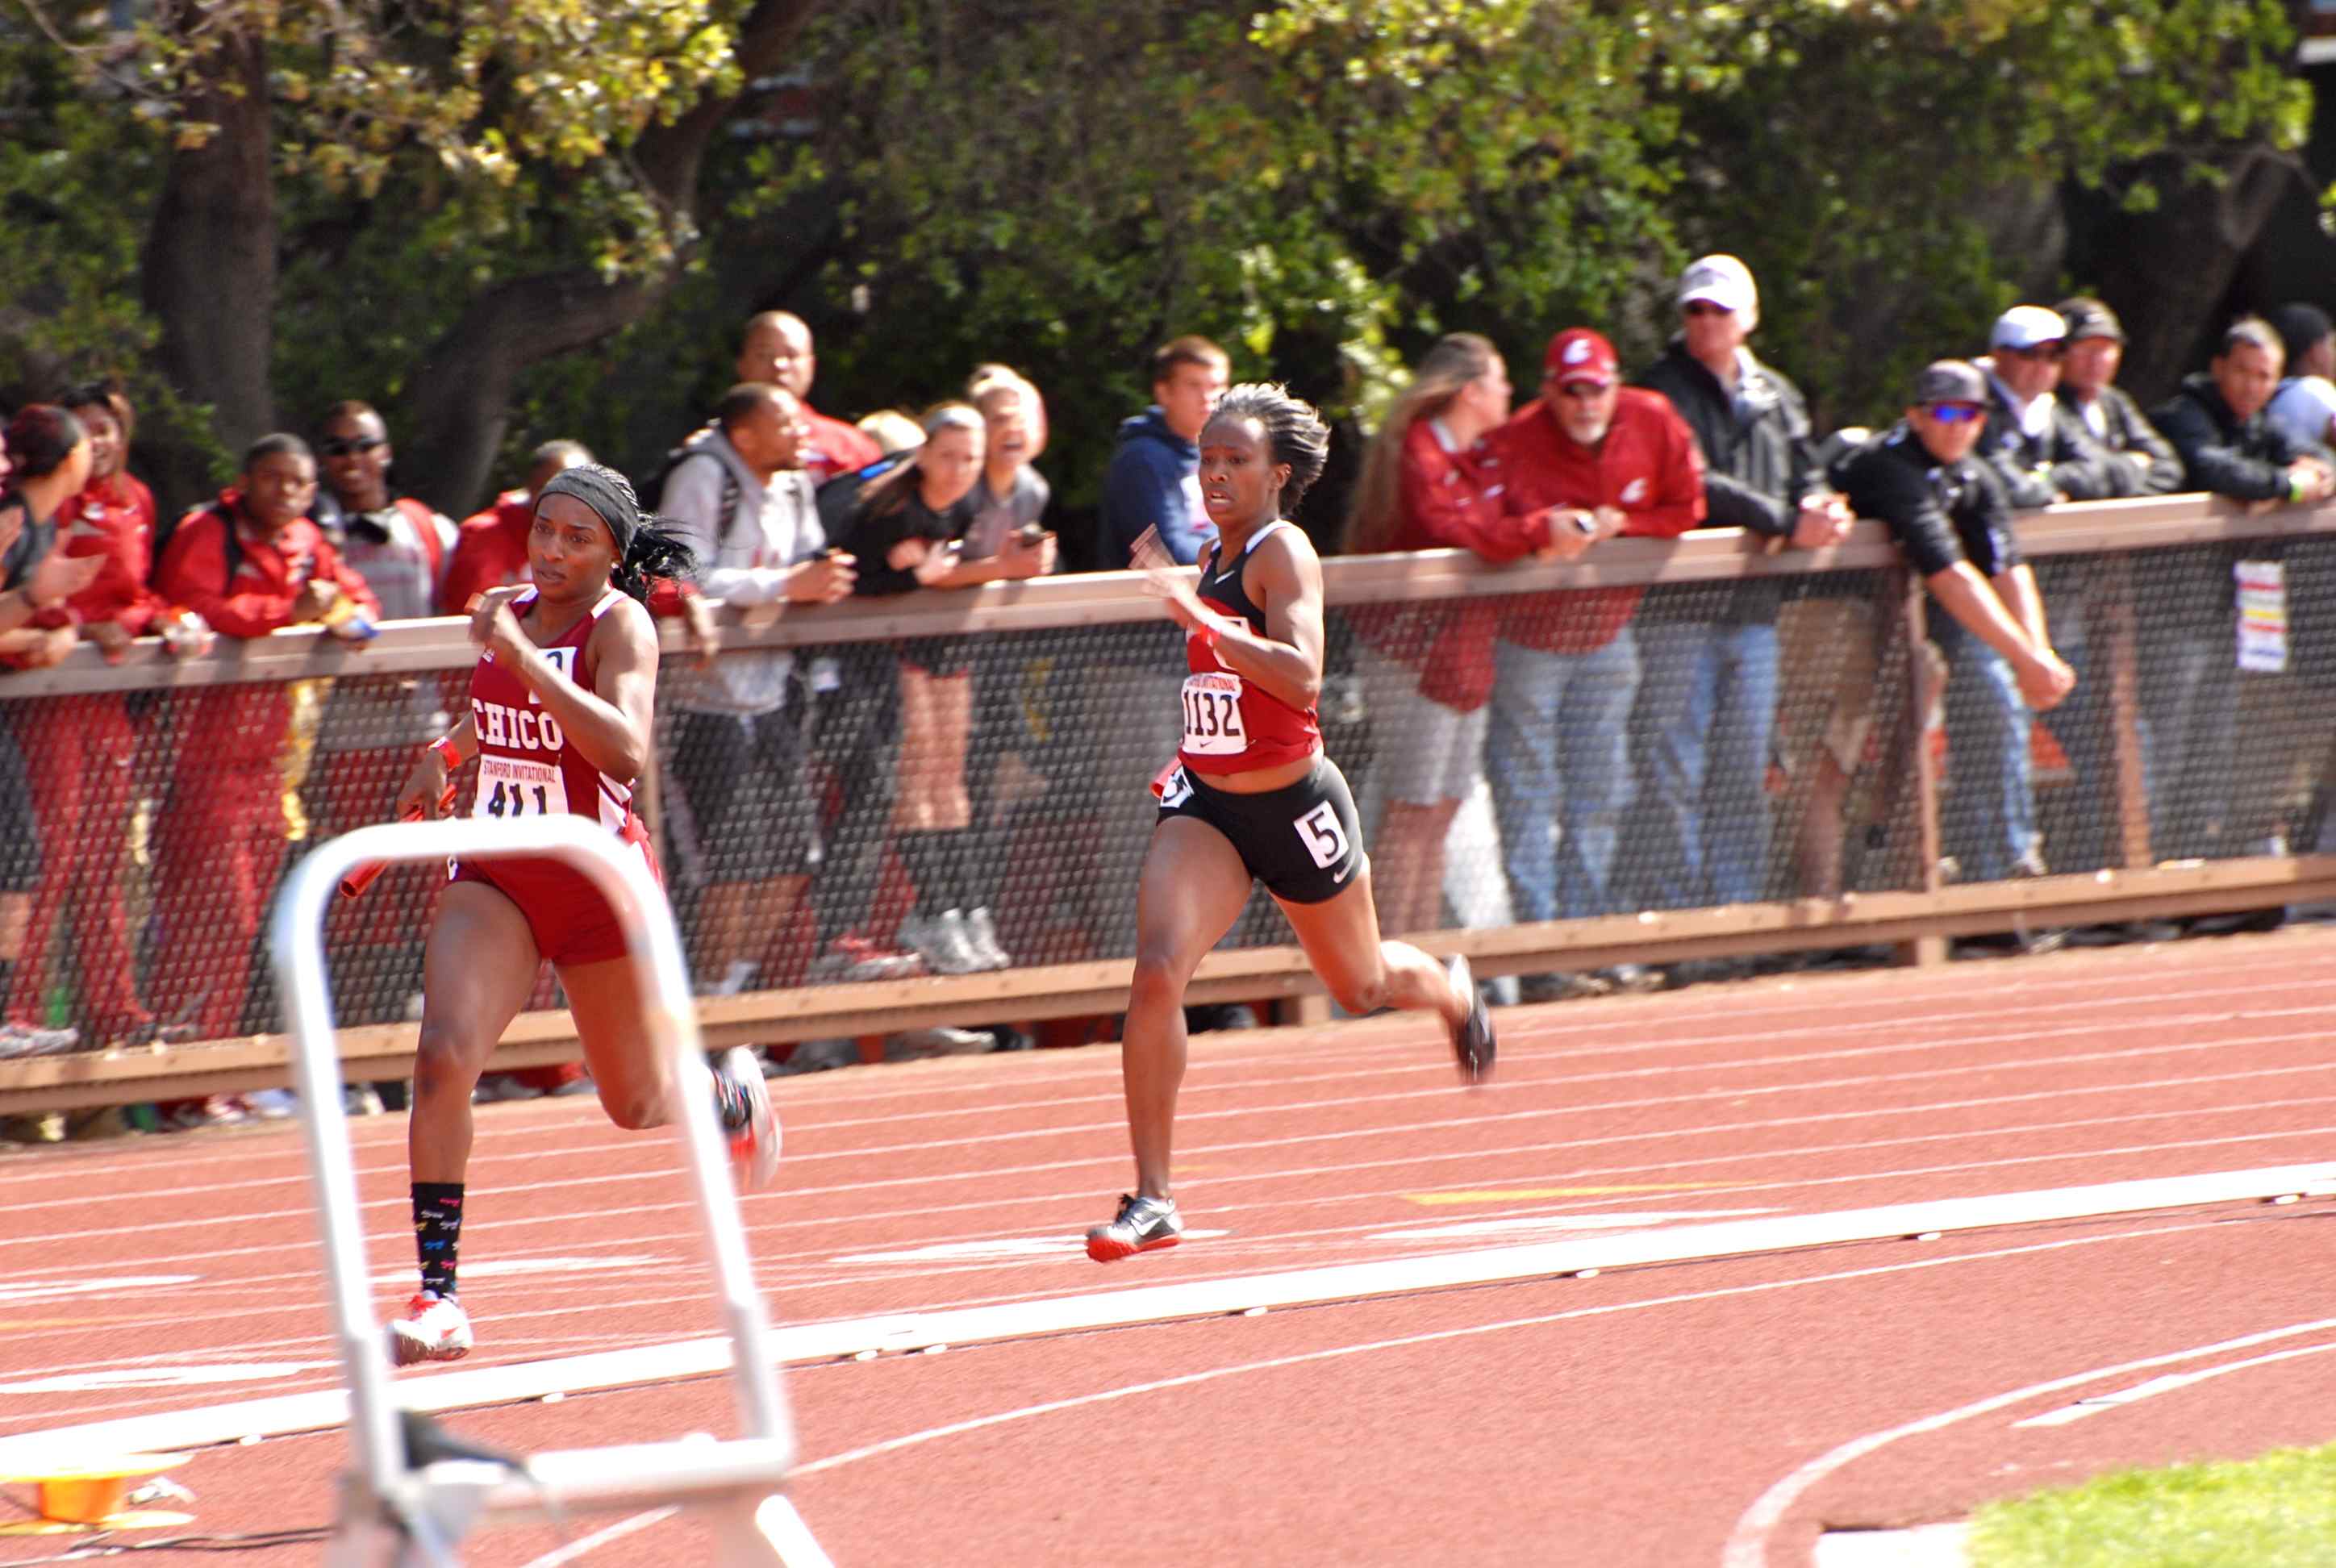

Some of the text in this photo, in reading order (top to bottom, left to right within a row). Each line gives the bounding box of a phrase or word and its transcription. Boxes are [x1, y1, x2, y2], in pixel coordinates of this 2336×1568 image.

[471, 698, 564, 751] CHICO
[1183, 690, 1241, 737] 1132
[484, 760, 556, 783] STANFORD INVITATIONAL
[487, 781, 548, 819] 411
[1307, 811, 1339, 860] 5
